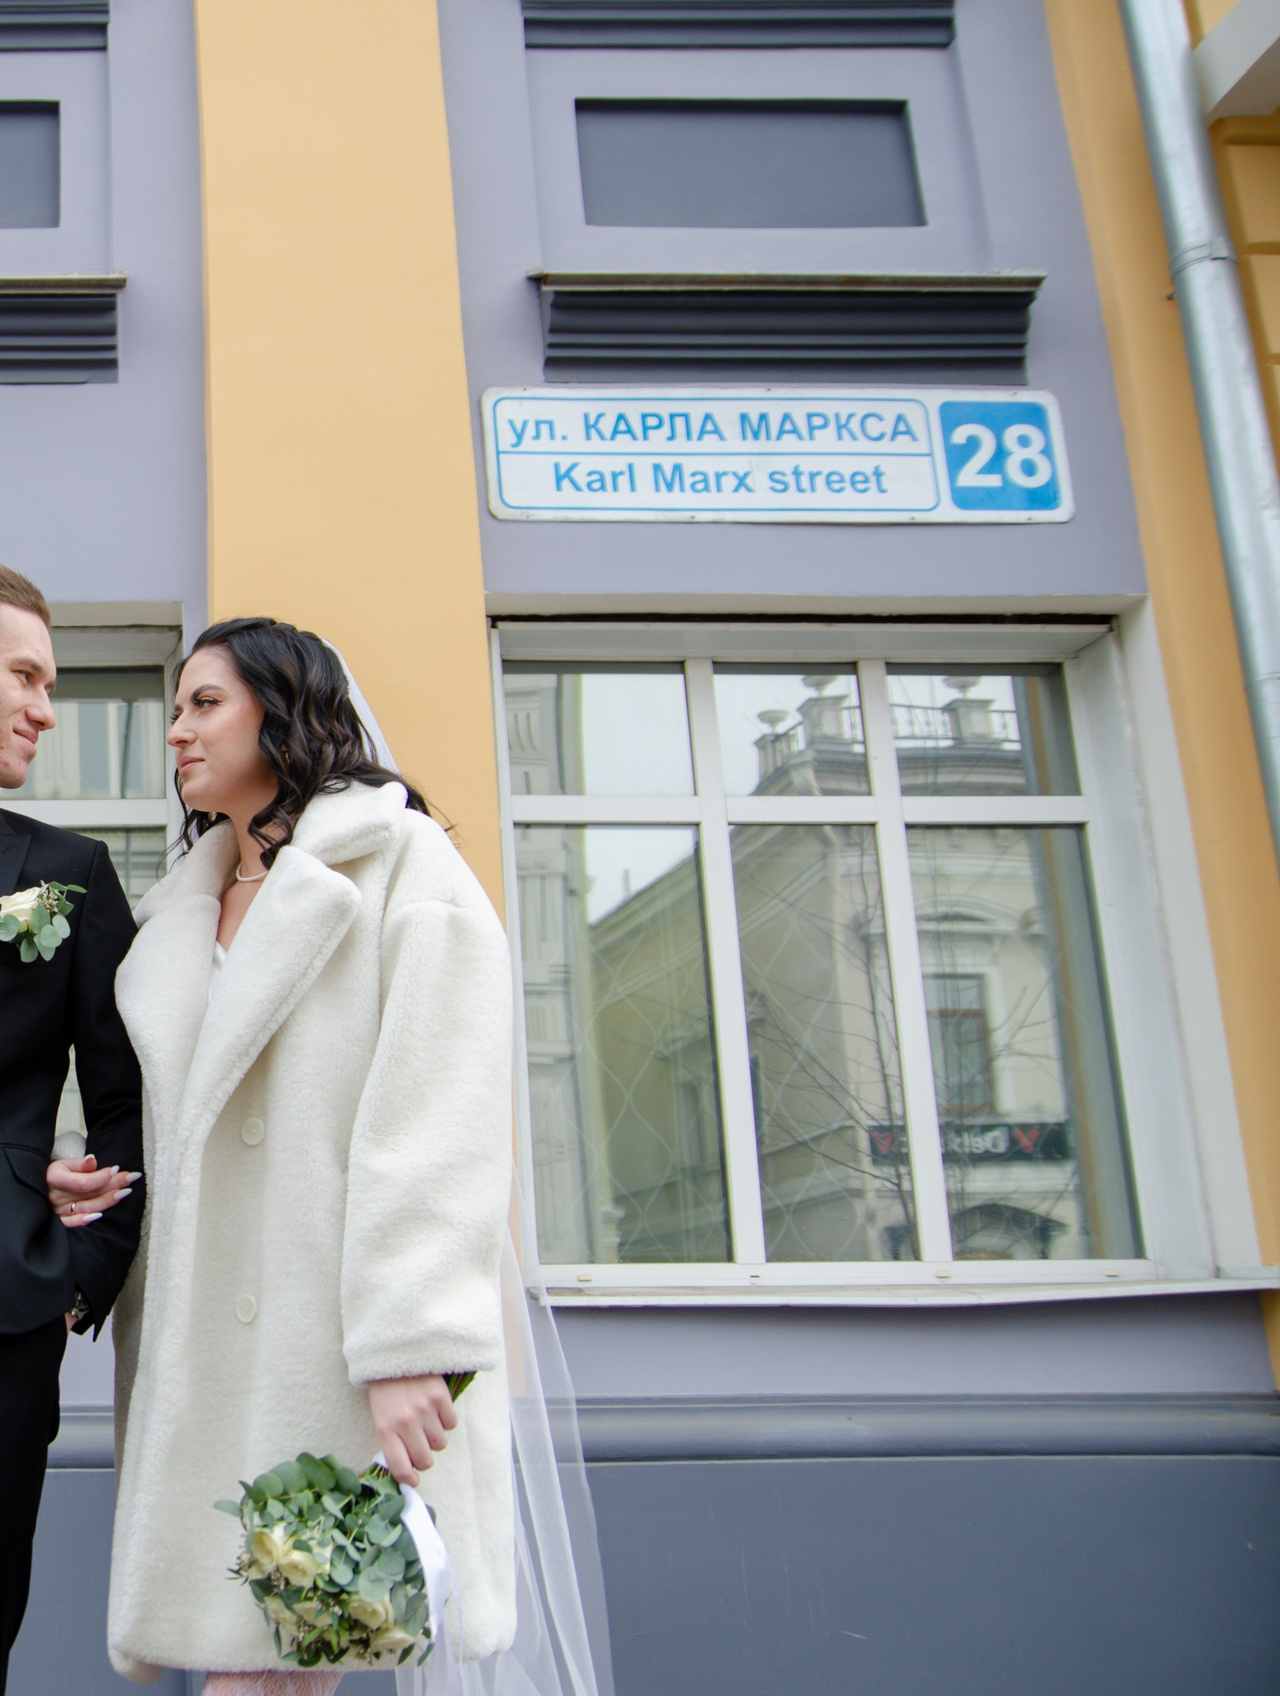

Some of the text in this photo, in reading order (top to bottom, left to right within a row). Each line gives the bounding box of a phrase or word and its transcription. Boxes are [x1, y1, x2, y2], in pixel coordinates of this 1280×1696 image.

[508, 411, 919, 449] ул. КАРЛА МАРКСА
[951, 423, 1052, 488] 28
[553, 461, 888, 494] Karl Marx street
